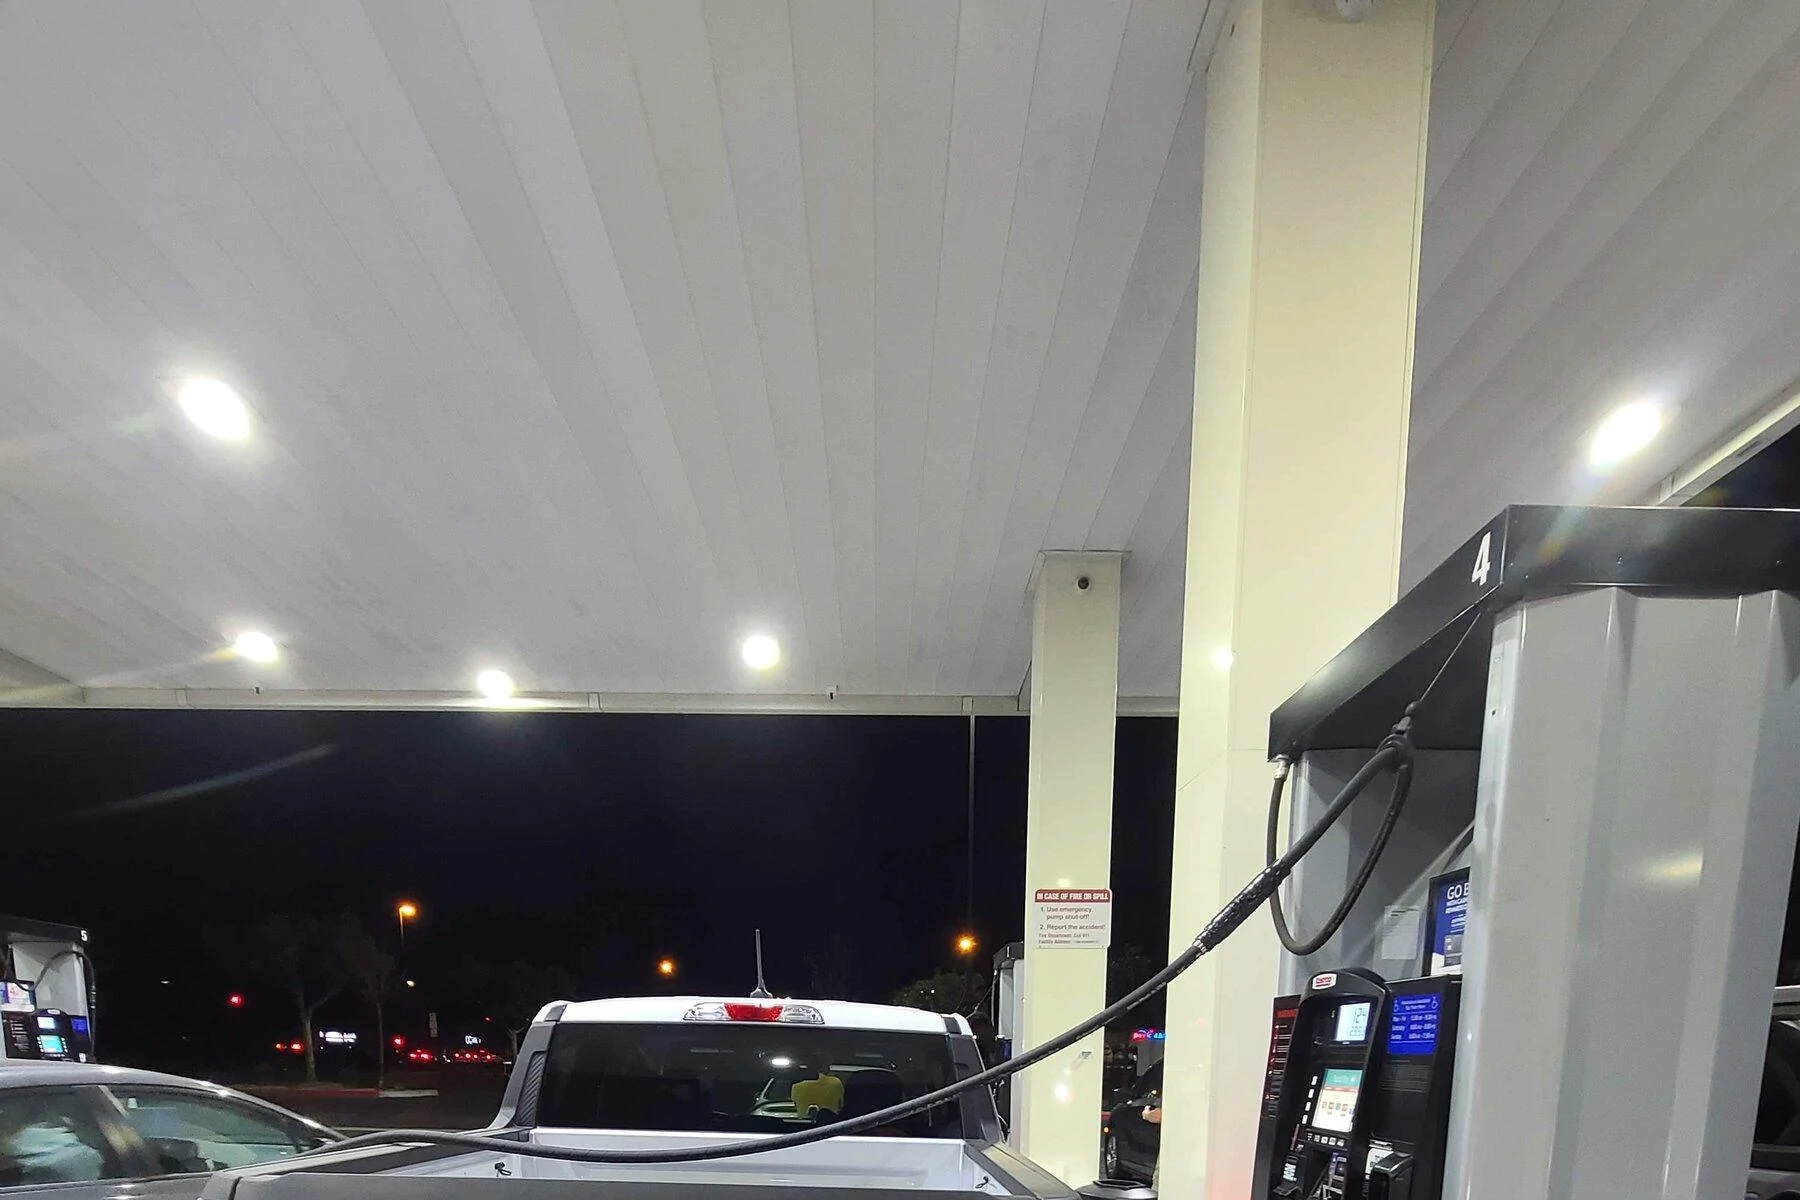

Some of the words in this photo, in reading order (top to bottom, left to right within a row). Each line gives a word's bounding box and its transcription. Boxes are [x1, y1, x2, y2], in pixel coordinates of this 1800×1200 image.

[1471, 531, 1491, 587] 4
[1447, 884, 1462, 900] GO
[80, 930, 88, 941] 5
